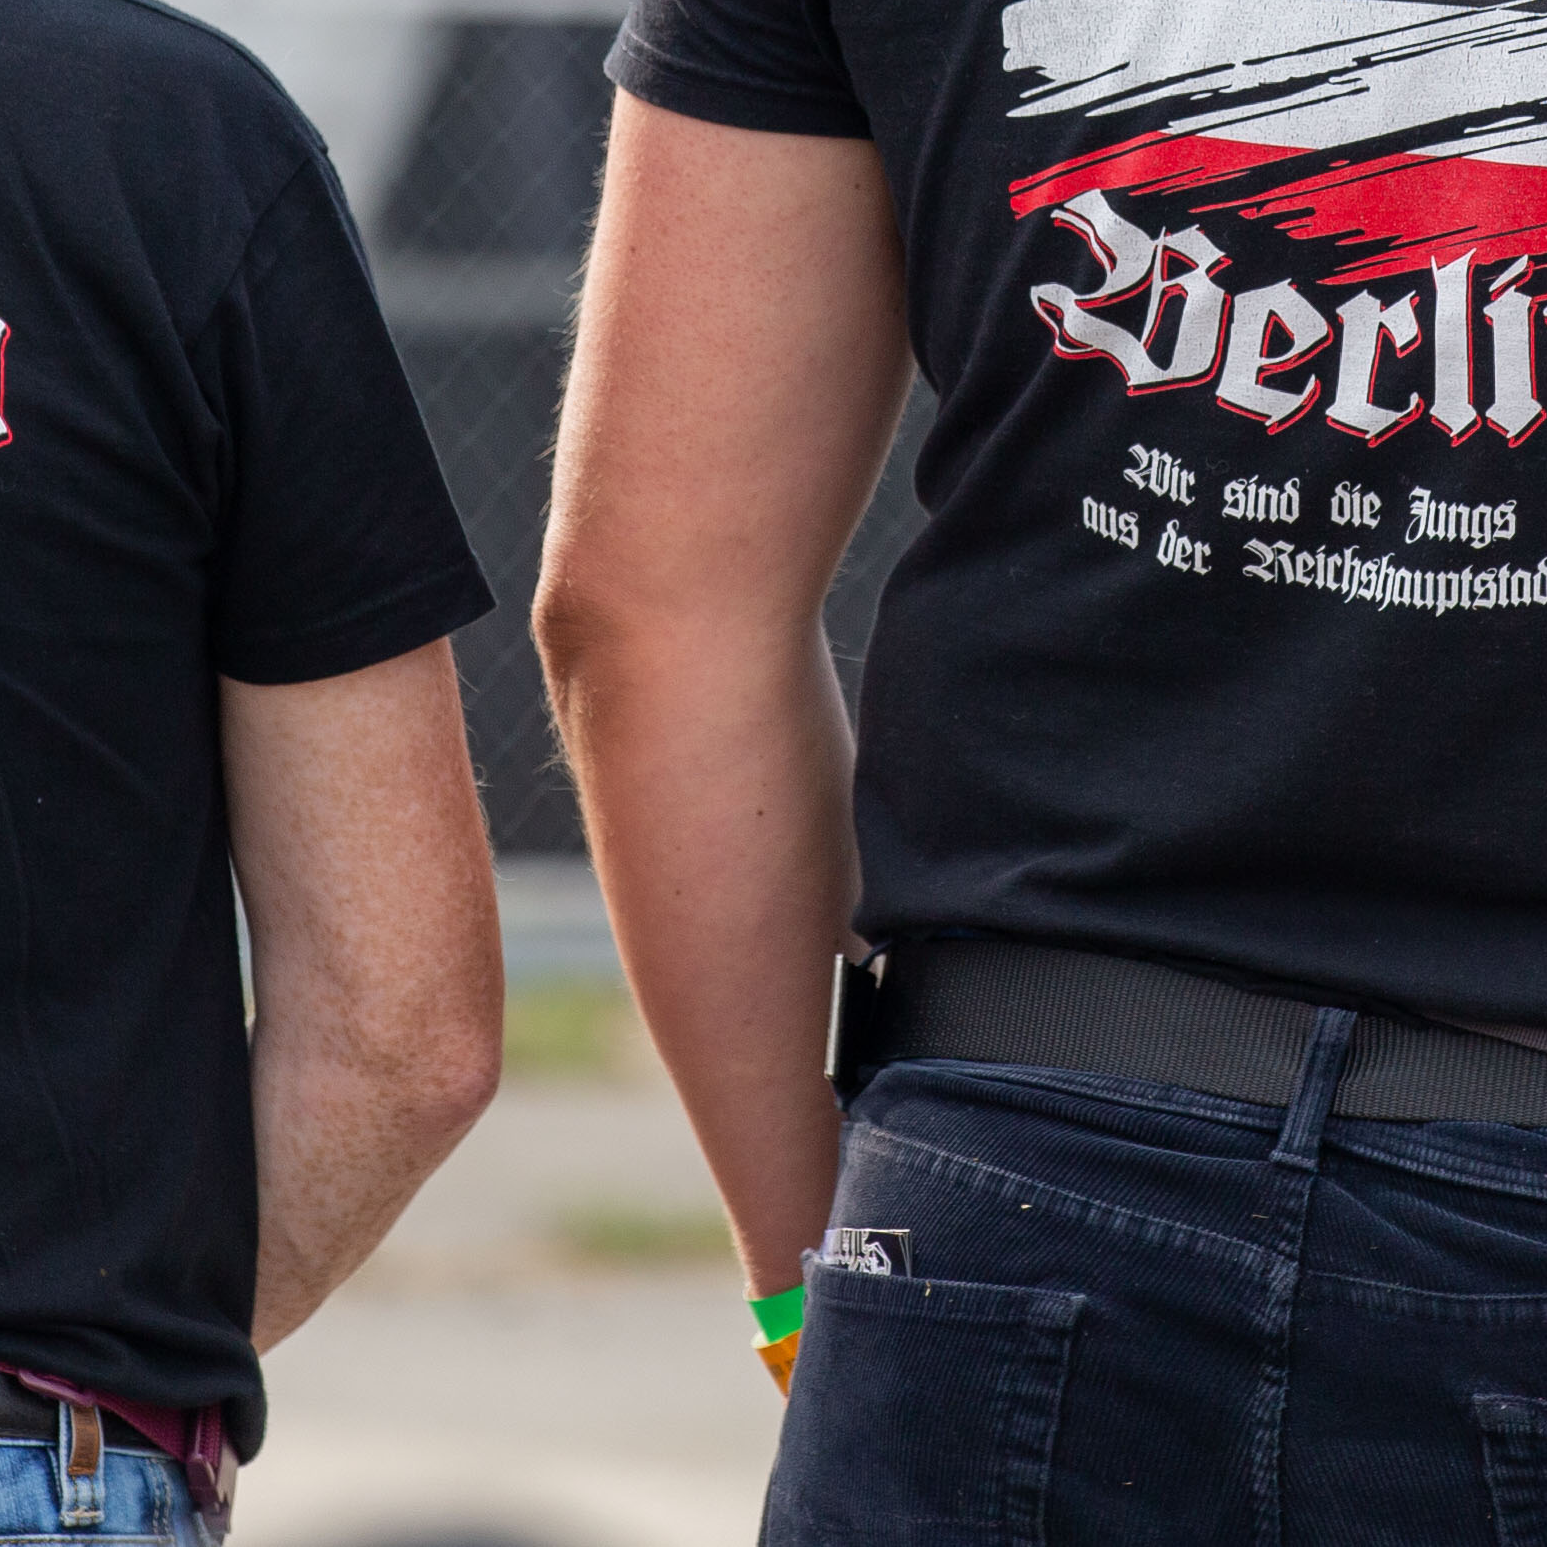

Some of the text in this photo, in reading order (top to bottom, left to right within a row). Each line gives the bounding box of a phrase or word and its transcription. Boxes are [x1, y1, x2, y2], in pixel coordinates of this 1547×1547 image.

[1082, 495, 1139, 550] aus
[1155, 518, 1212, 576] der
[1123, 443, 1518, 550] Wir sind die Jungs
